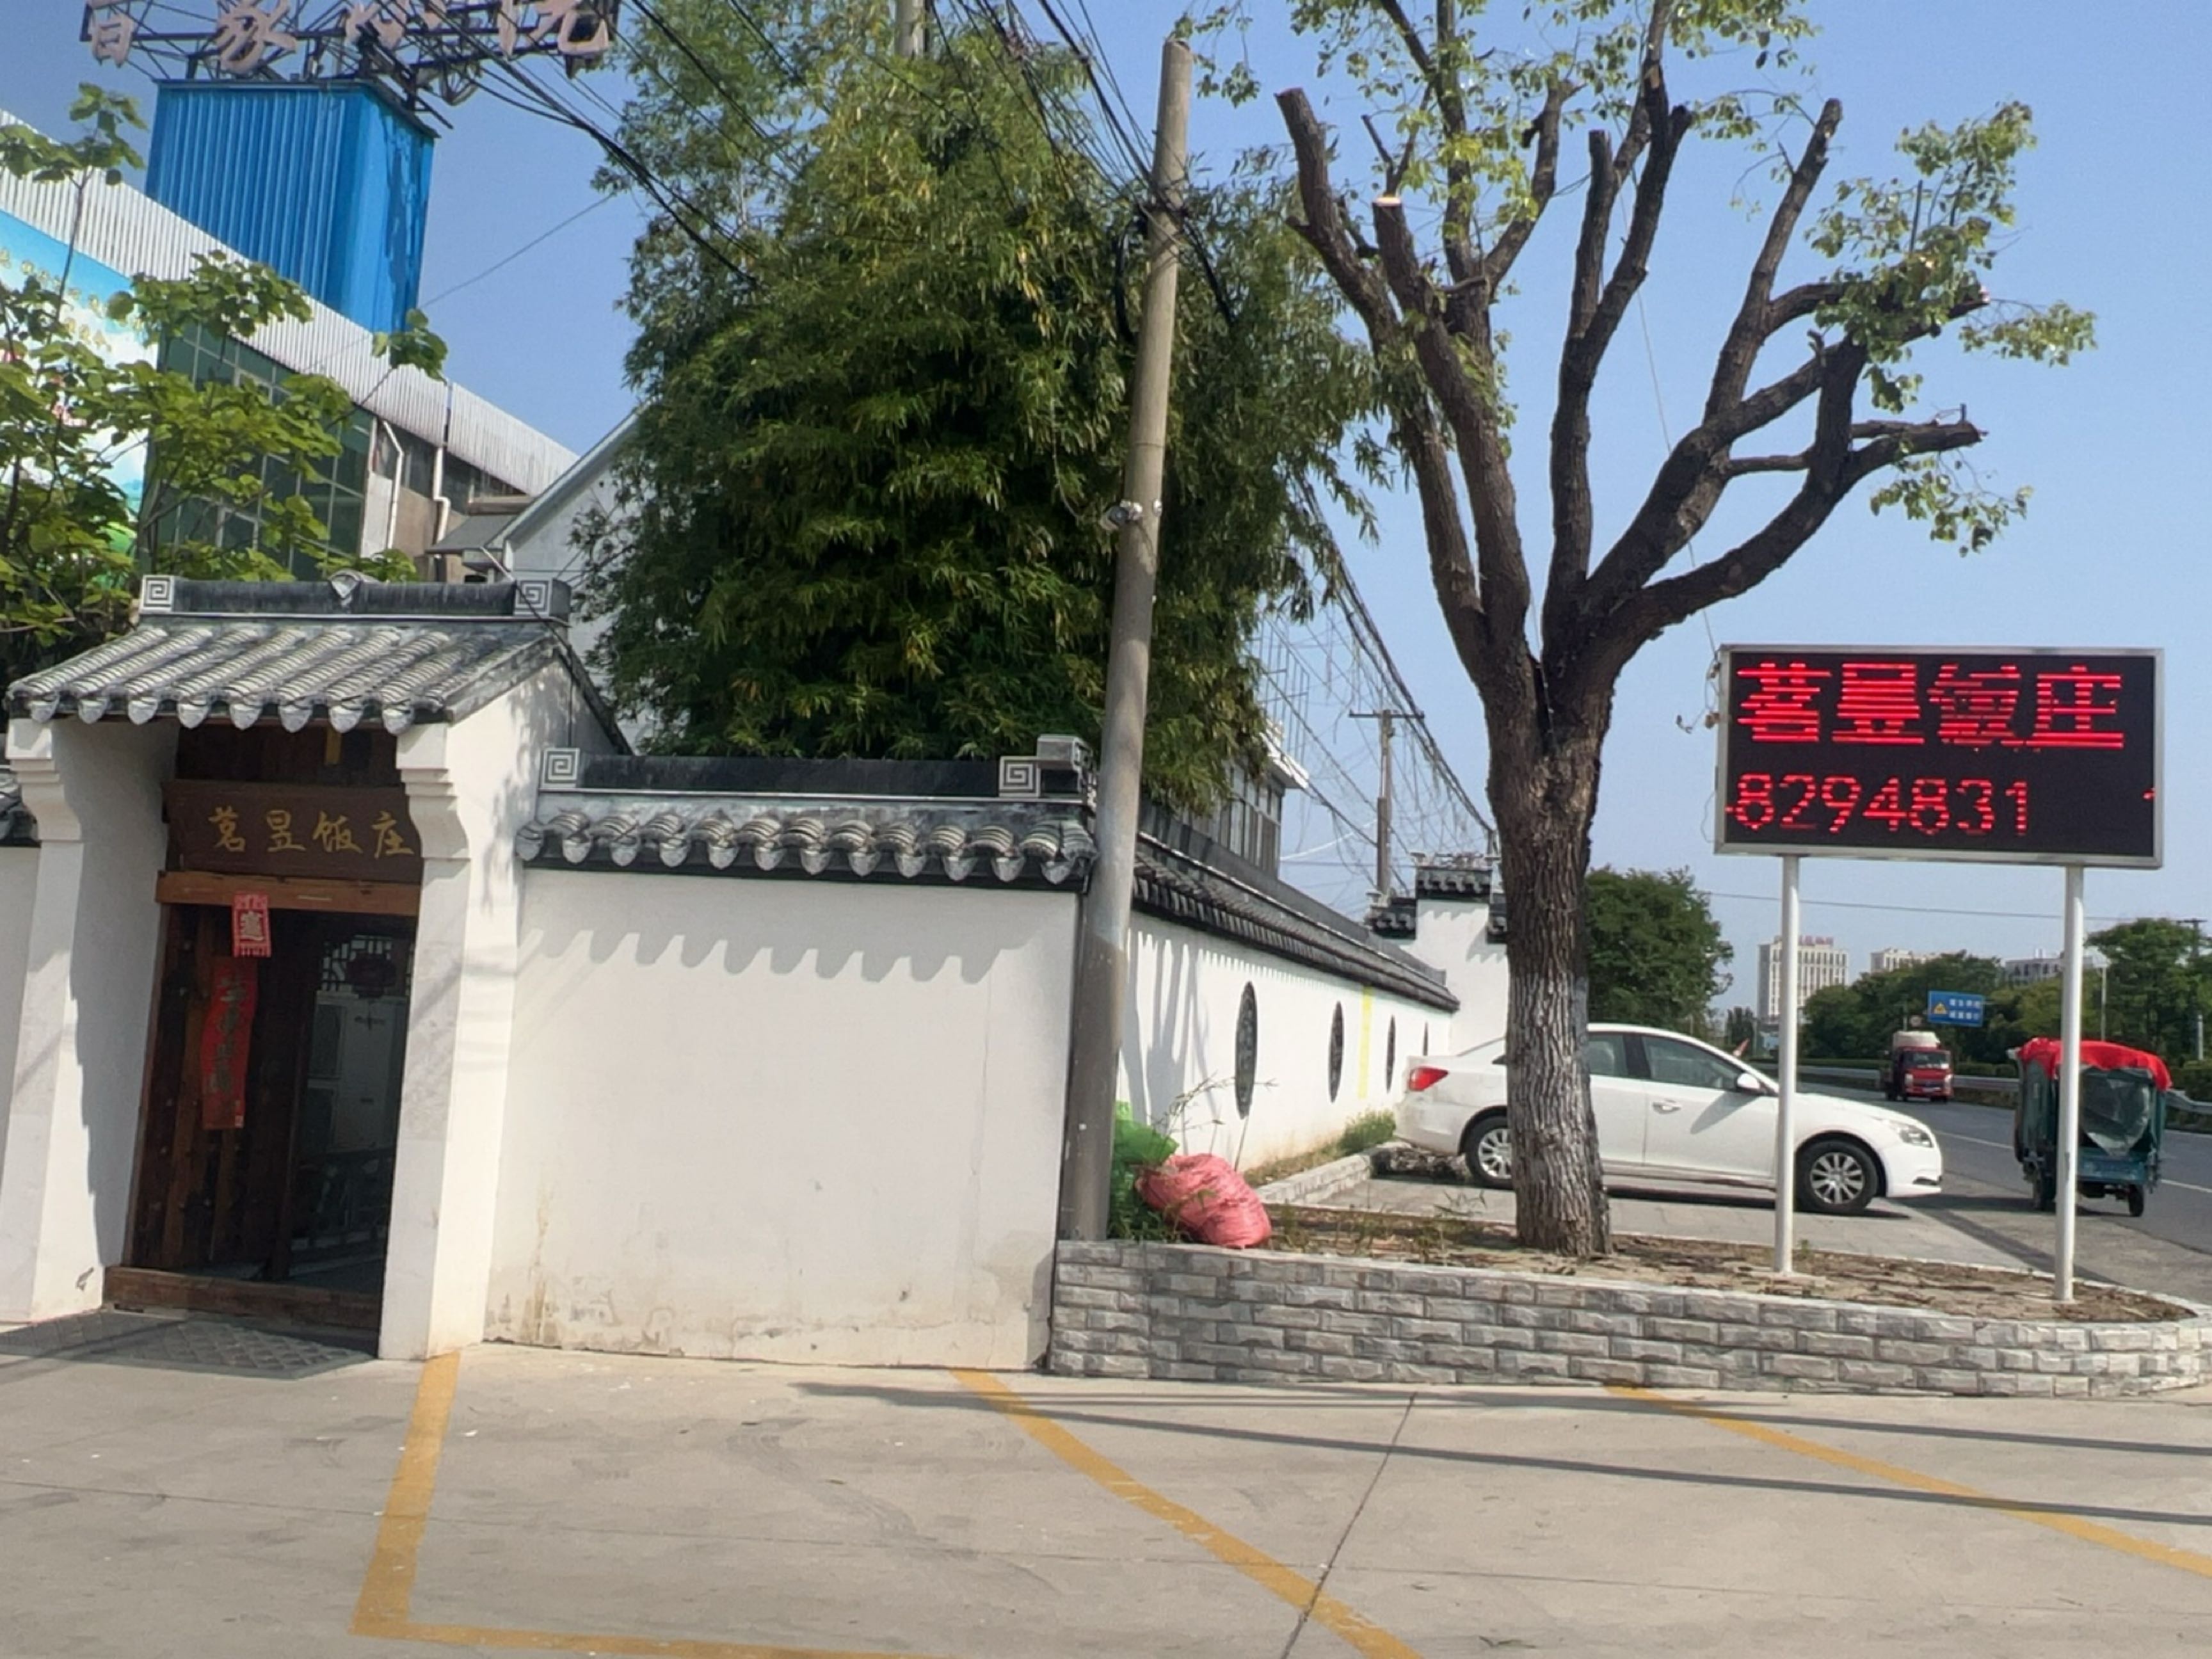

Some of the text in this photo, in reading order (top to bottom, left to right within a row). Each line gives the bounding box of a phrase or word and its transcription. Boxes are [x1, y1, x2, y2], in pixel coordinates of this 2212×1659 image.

[208, 805, 415, 860] 茗昱饭庄
[1734, 773, 2028, 835] 8294831
